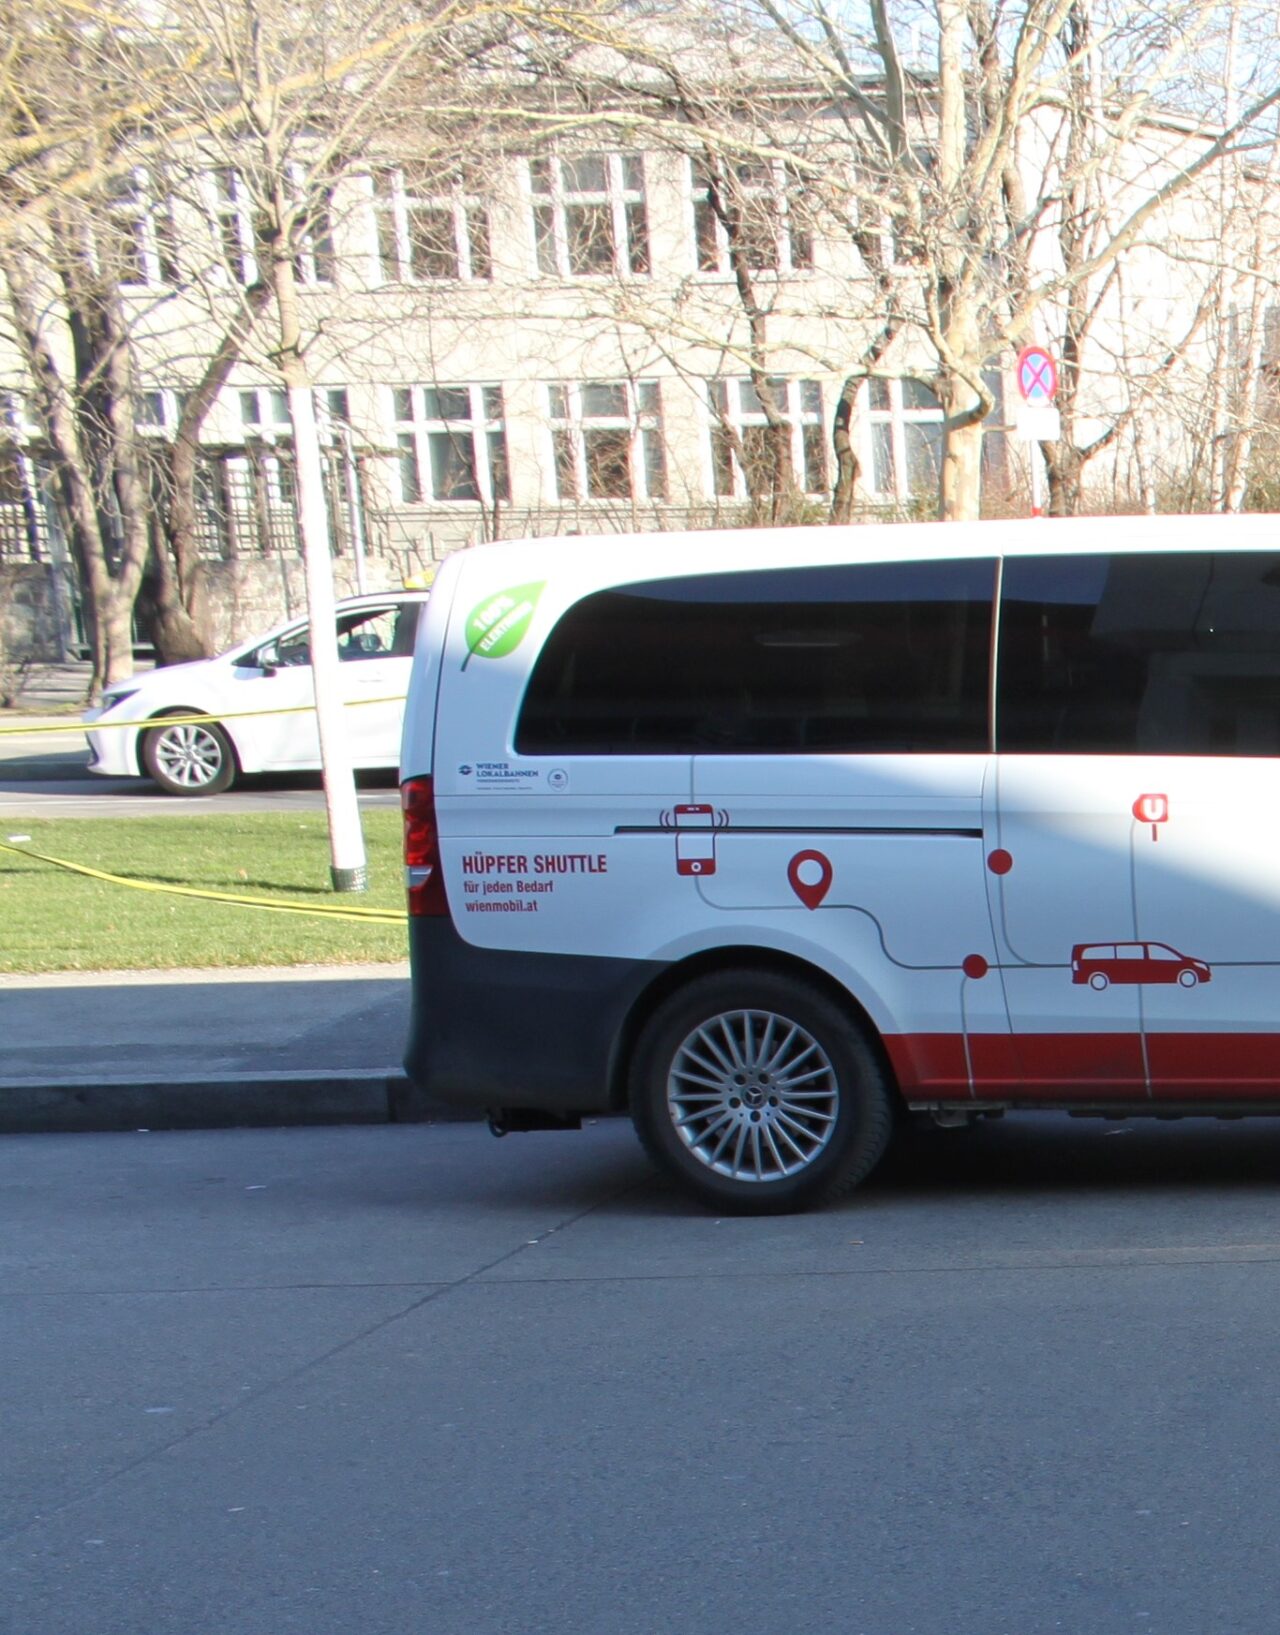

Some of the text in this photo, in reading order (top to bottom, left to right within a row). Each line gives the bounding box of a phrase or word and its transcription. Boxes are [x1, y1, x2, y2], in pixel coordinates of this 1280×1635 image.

[476, 770, 539, 778] LOKALBAHNEN
[462, 851, 608, 874] HÜPFER SHUTTLE
[463, 880, 554, 896] für jeden Bedarf
[465, 900, 539, 912] wienmobil.at
